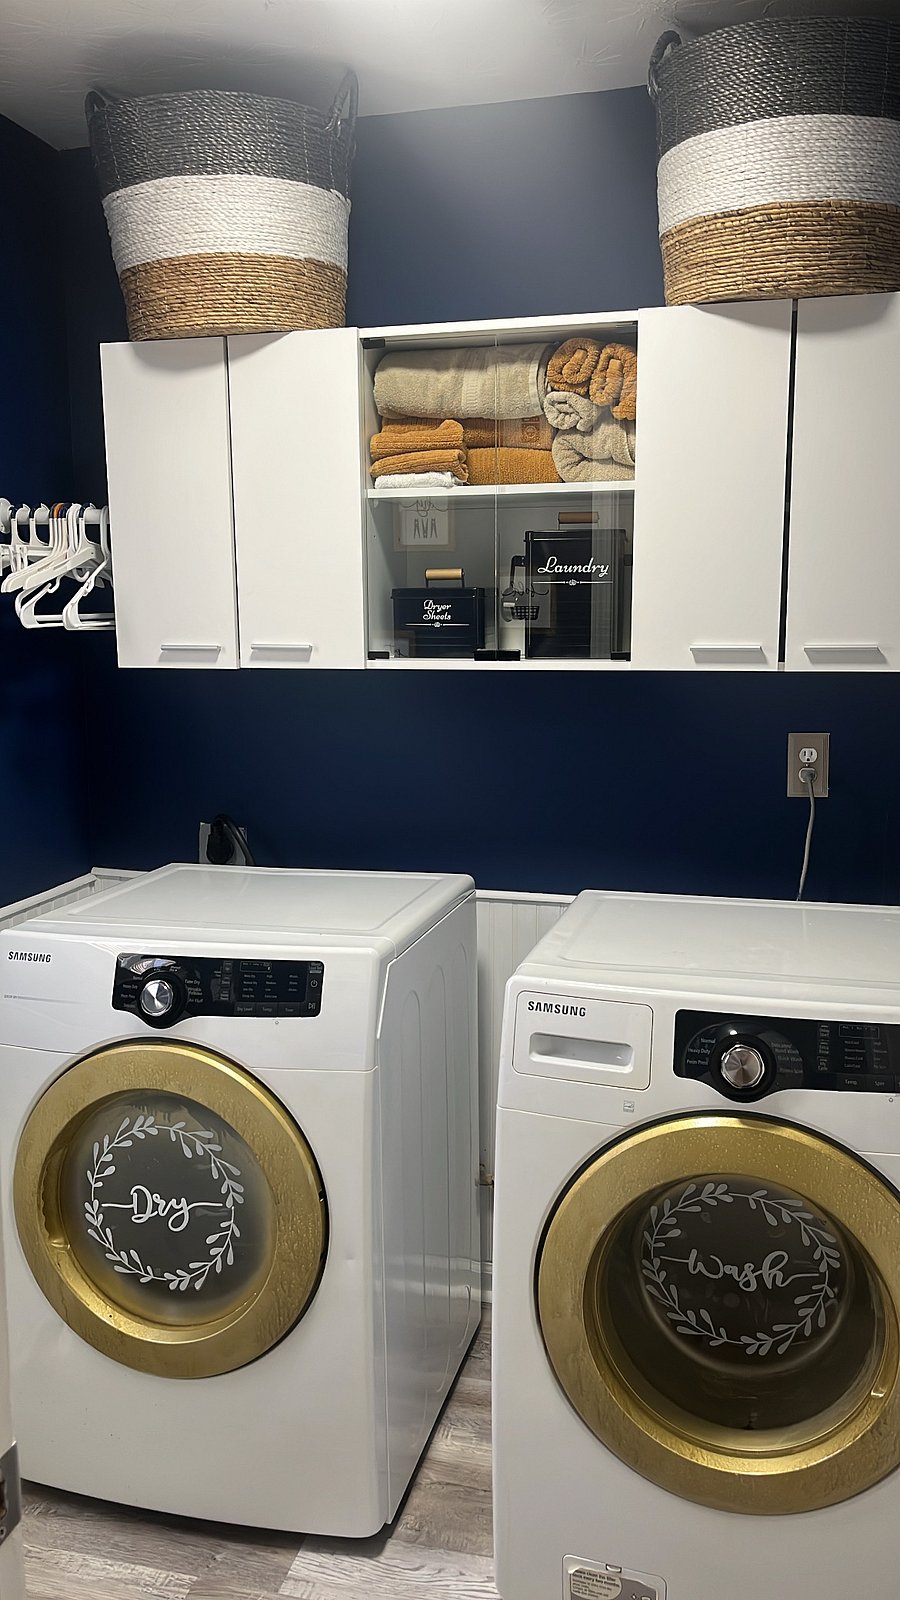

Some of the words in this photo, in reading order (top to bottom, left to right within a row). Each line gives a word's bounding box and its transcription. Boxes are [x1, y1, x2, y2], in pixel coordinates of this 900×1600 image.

[537, 556, 610, 578] Laundry
[423, 600, 452, 612] Dryer
[422, 610, 452, 621] Sheets
[8, 951, 52, 963] SAMSUNG
[527, 1000, 587, 1017] SAMSUNG
[116, 1185, 206, 1232] Dry
[675, 1248, 803, 1292] Wash
